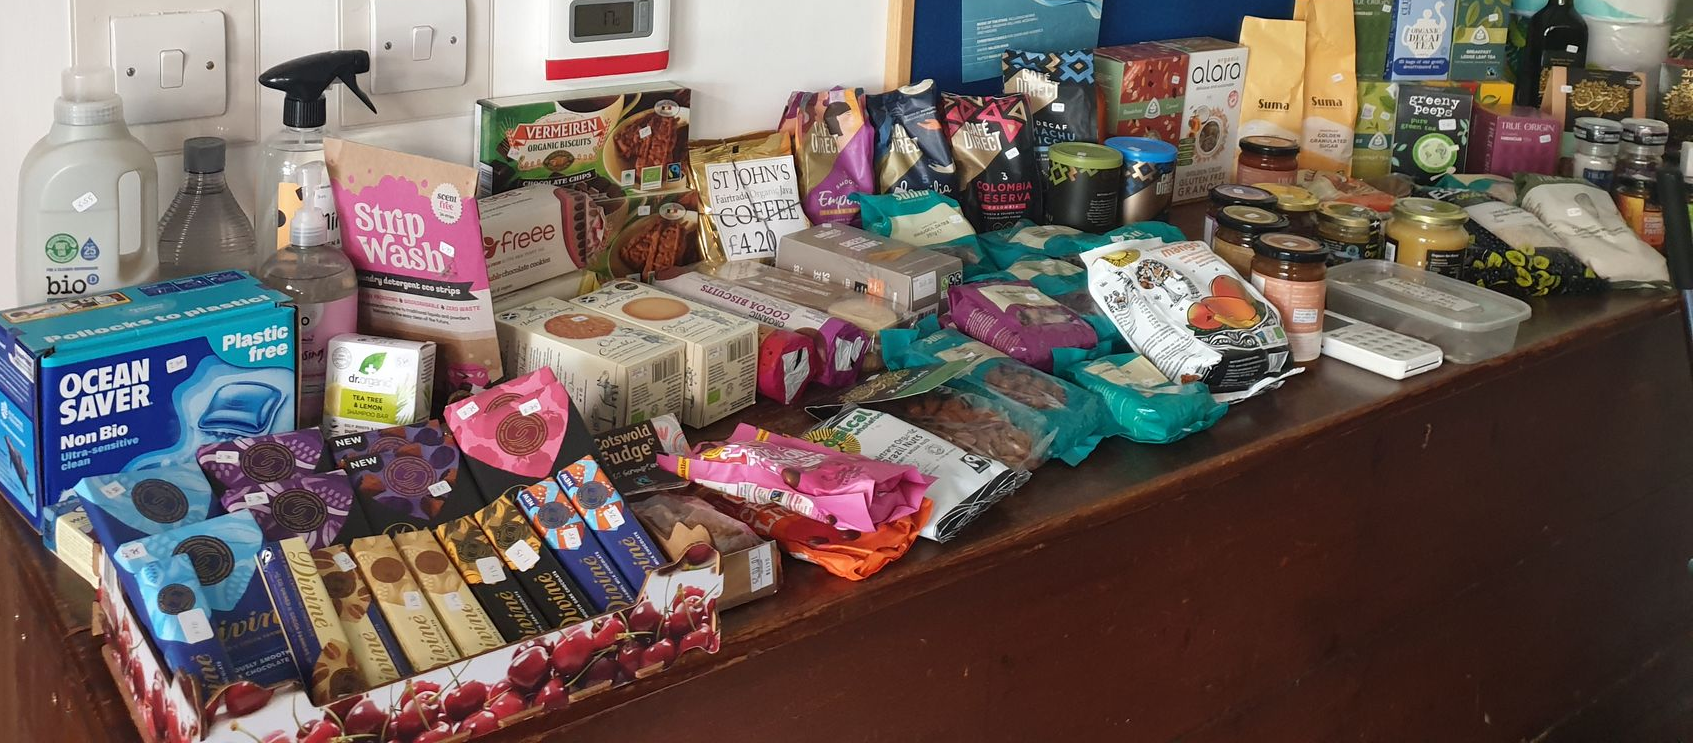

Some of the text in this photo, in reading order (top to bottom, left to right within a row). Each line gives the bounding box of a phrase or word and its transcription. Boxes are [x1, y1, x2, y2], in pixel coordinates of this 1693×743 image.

[1409, 34, 1442, 43] DECAF
[1414, 42, 1435, 50] TEA
[1191, 59, 1241, 85] alara
[1016, 77, 1060, 99] DIRECT
[1258, 98, 1290, 111] Suma
[1311, 96, 1343, 107] Suma
[1408, 95, 1461, 110] greeny
[1413, 105, 1453, 117] peeps
[525, 118, 598, 139] VERMEIREN
[964, 119, 991, 136] CAFÉ
[1035, 120, 1068, 130] DECAF
[1400, 123, 1422, 131] green
[1410, 118, 1428, 126] pure
[1501, 121, 1556, 133] TRUE ORIGIN
[527, 138, 592, 152] ORGANIC BISCUITS
[811, 133, 841, 154] DIRECT
[963, 130, 1003, 151] DIRECT
[569, 171, 592, 183] CHIPS
[711, 163, 791, 191] ST JOHN'S
[1000, 171, 1008, 181] 3
[715, 185, 793, 204] Fairtrade Organic Java
[976, 181, 1033, 193] COLOMBIA
[436, 192, 458, 203] scent
[439, 202, 454, 211] free
[978, 193, 1031, 203] RESERVA
[719, 199, 800, 228] COFFEE
[354, 202, 425, 247] Strip
[501, 224, 555, 253] freee
[728, 229, 778, 257] £4.20
[83, 246, 97, 256] 25
[356, 234, 446, 274] Wash
[1160, 241, 1201, 259] mango
[46, 275, 87, 295] bio
[383, 276, 421, 291] detergent
[421, 283, 435, 292] eco
[435, 286, 461, 297] strips
[700, 283, 748, 308] BISCUITS
[43, 293, 272, 344] Pollocks to plastic!
[749, 298, 791, 321] COCOA
[222, 324, 289, 352] Plastic
[248, 341, 289, 364] free
[59, 357, 150, 399] OCEAN
[59, 384, 151, 426] SAVER
[352, 394, 383, 404] TEA TREE
[359, 403, 383, 411] LEMON
[347, 409, 375, 418] SHAMPOO
[60, 422, 129, 451] Non Bio
[335, 435, 362, 447] NEW
[594, 424, 652, 450] Cotswold
[60, 435, 140, 462] Ultra-sensitive
[601, 443, 652, 465] Fudge
[60, 456, 91, 471] clean
[350, 456, 378, 469] NEW
[561, 473, 574, 488] NEW
[521, 492, 535, 508] NEW
[287, 550, 335, 630] Divine
[498, 590, 539, 637] ivine
[461, 603, 498, 648] ivine
[412, 614, 451, 663] ivine
[259, 650, 292, 663] SMOOTH
[244, 656, 291, 679] CHOCOLATE
